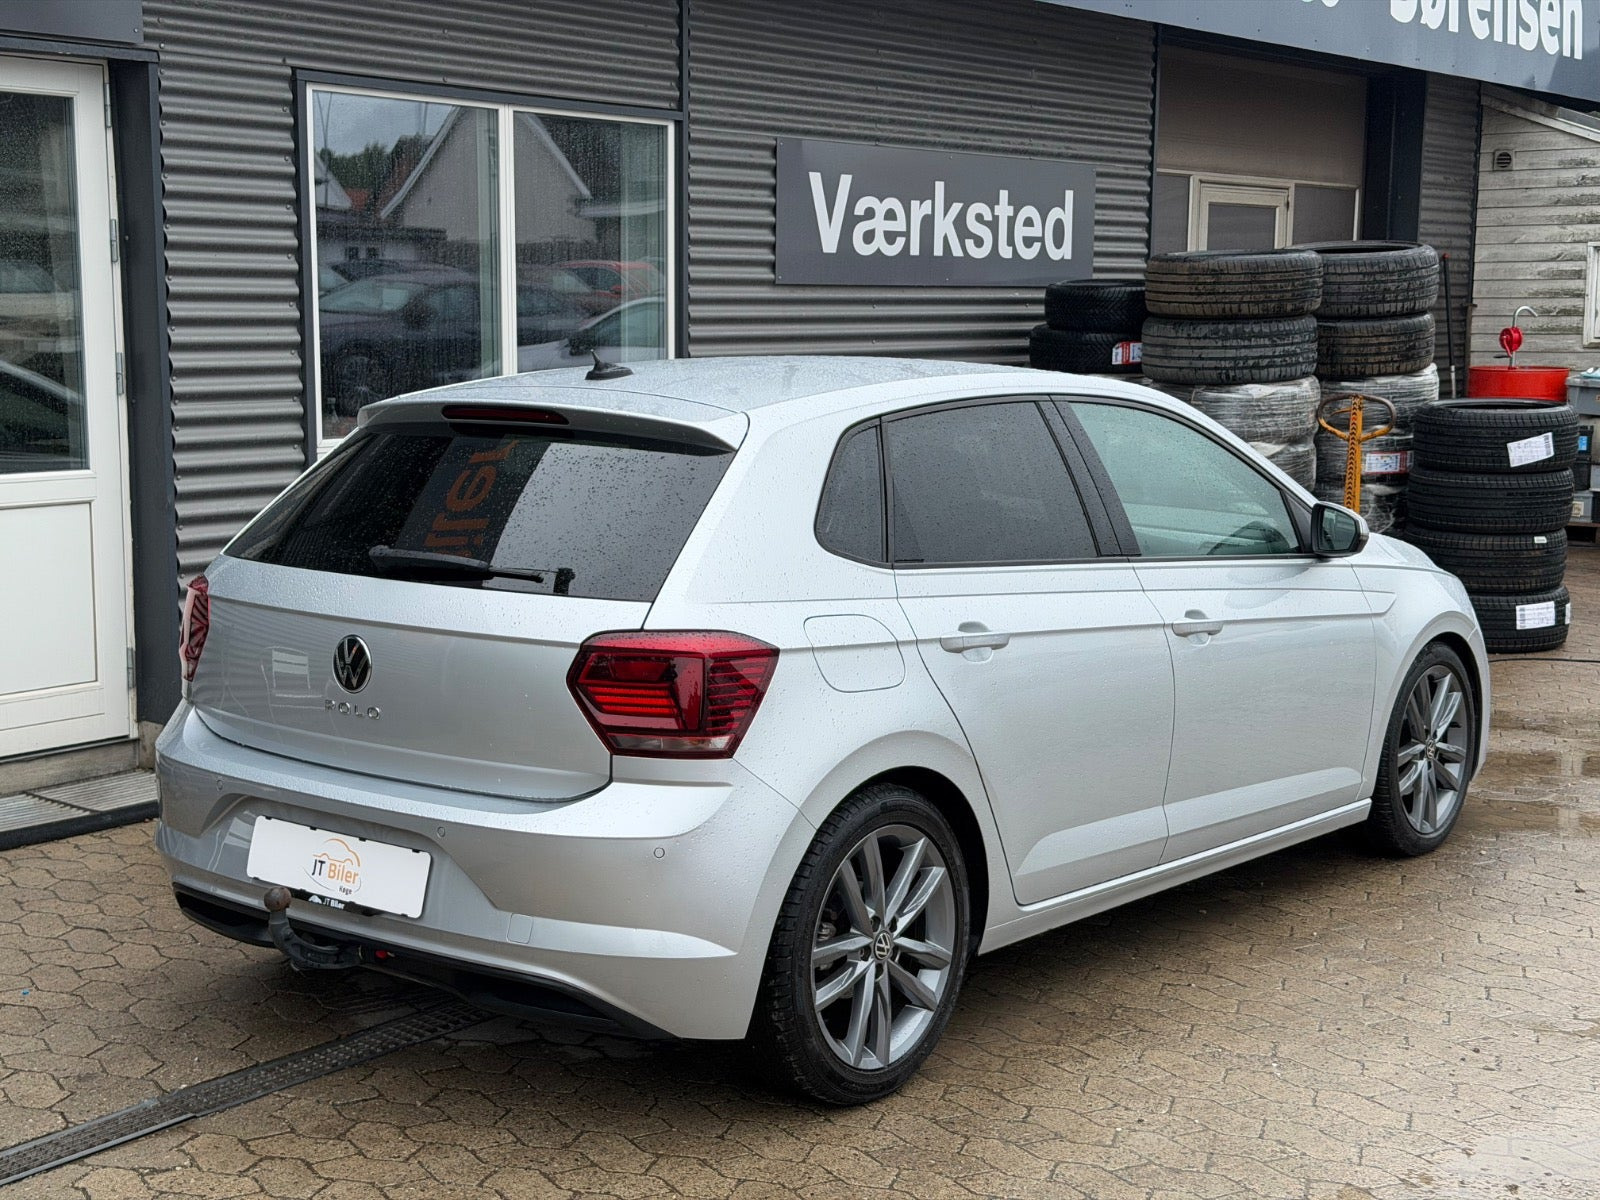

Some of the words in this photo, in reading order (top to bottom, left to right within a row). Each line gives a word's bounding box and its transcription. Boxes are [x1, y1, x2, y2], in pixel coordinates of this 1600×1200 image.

[808, 171, 1074, 261] Værksted
[324, 699, 381, 720] POLO
[311, 859, 326, 876] JT
[328, 863, 359, 884] Biler
